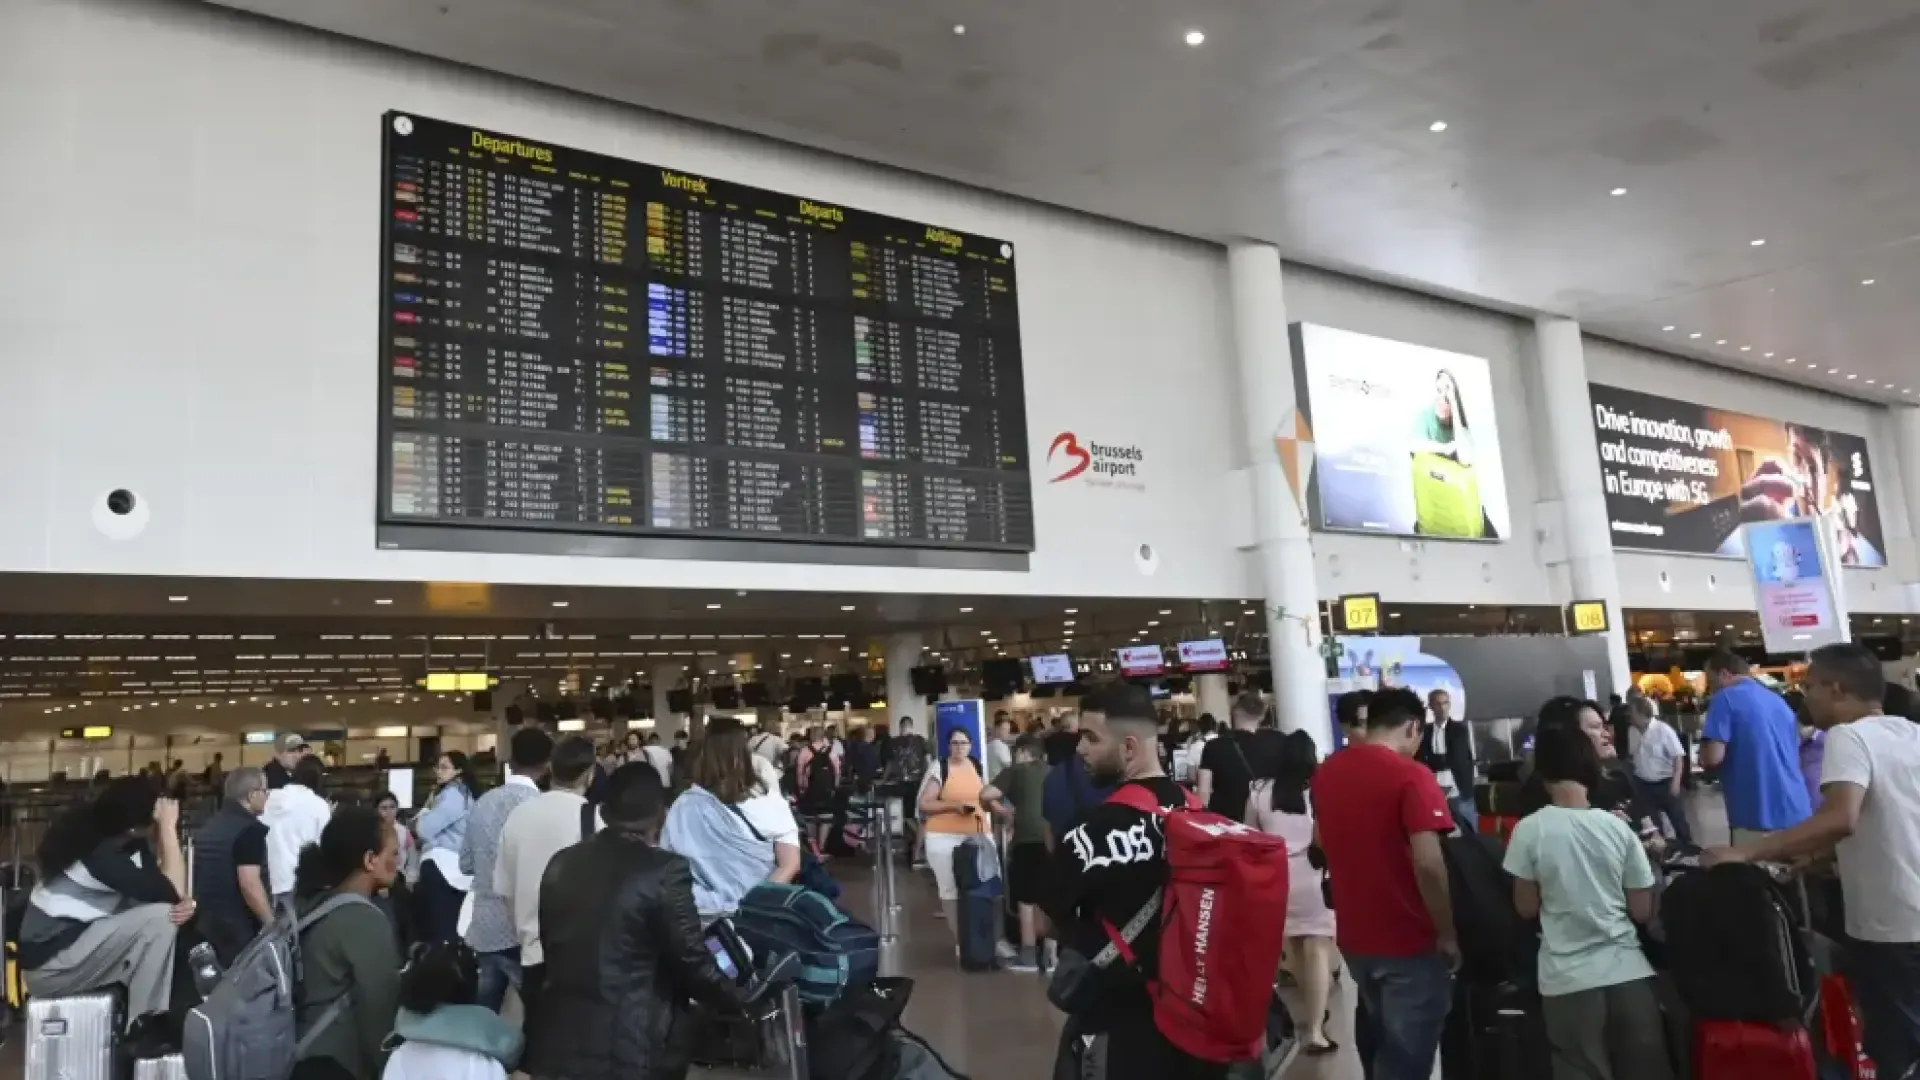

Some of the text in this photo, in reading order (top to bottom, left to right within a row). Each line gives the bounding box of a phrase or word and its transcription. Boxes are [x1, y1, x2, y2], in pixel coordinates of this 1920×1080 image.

[471, 131, 553, 163] Departures
[661, 170, 707, 194] Vertrek
[800, 200, 844, 222] Départs
[1596, 403, 1734, 452] Drive innovation, growth
[1090, 440, 1143, 461] brussels
[1601, 439, 1719, 477] and competitiveness
[1092, 458, 1136, 477] airport
[1604, 467, 1709, 505] in Europe with 5G
[1349, 607, 1373, 625] 07
[1580, 612, 1602, 629] 08
[1194, 887, 1215, 955] HANSEN
